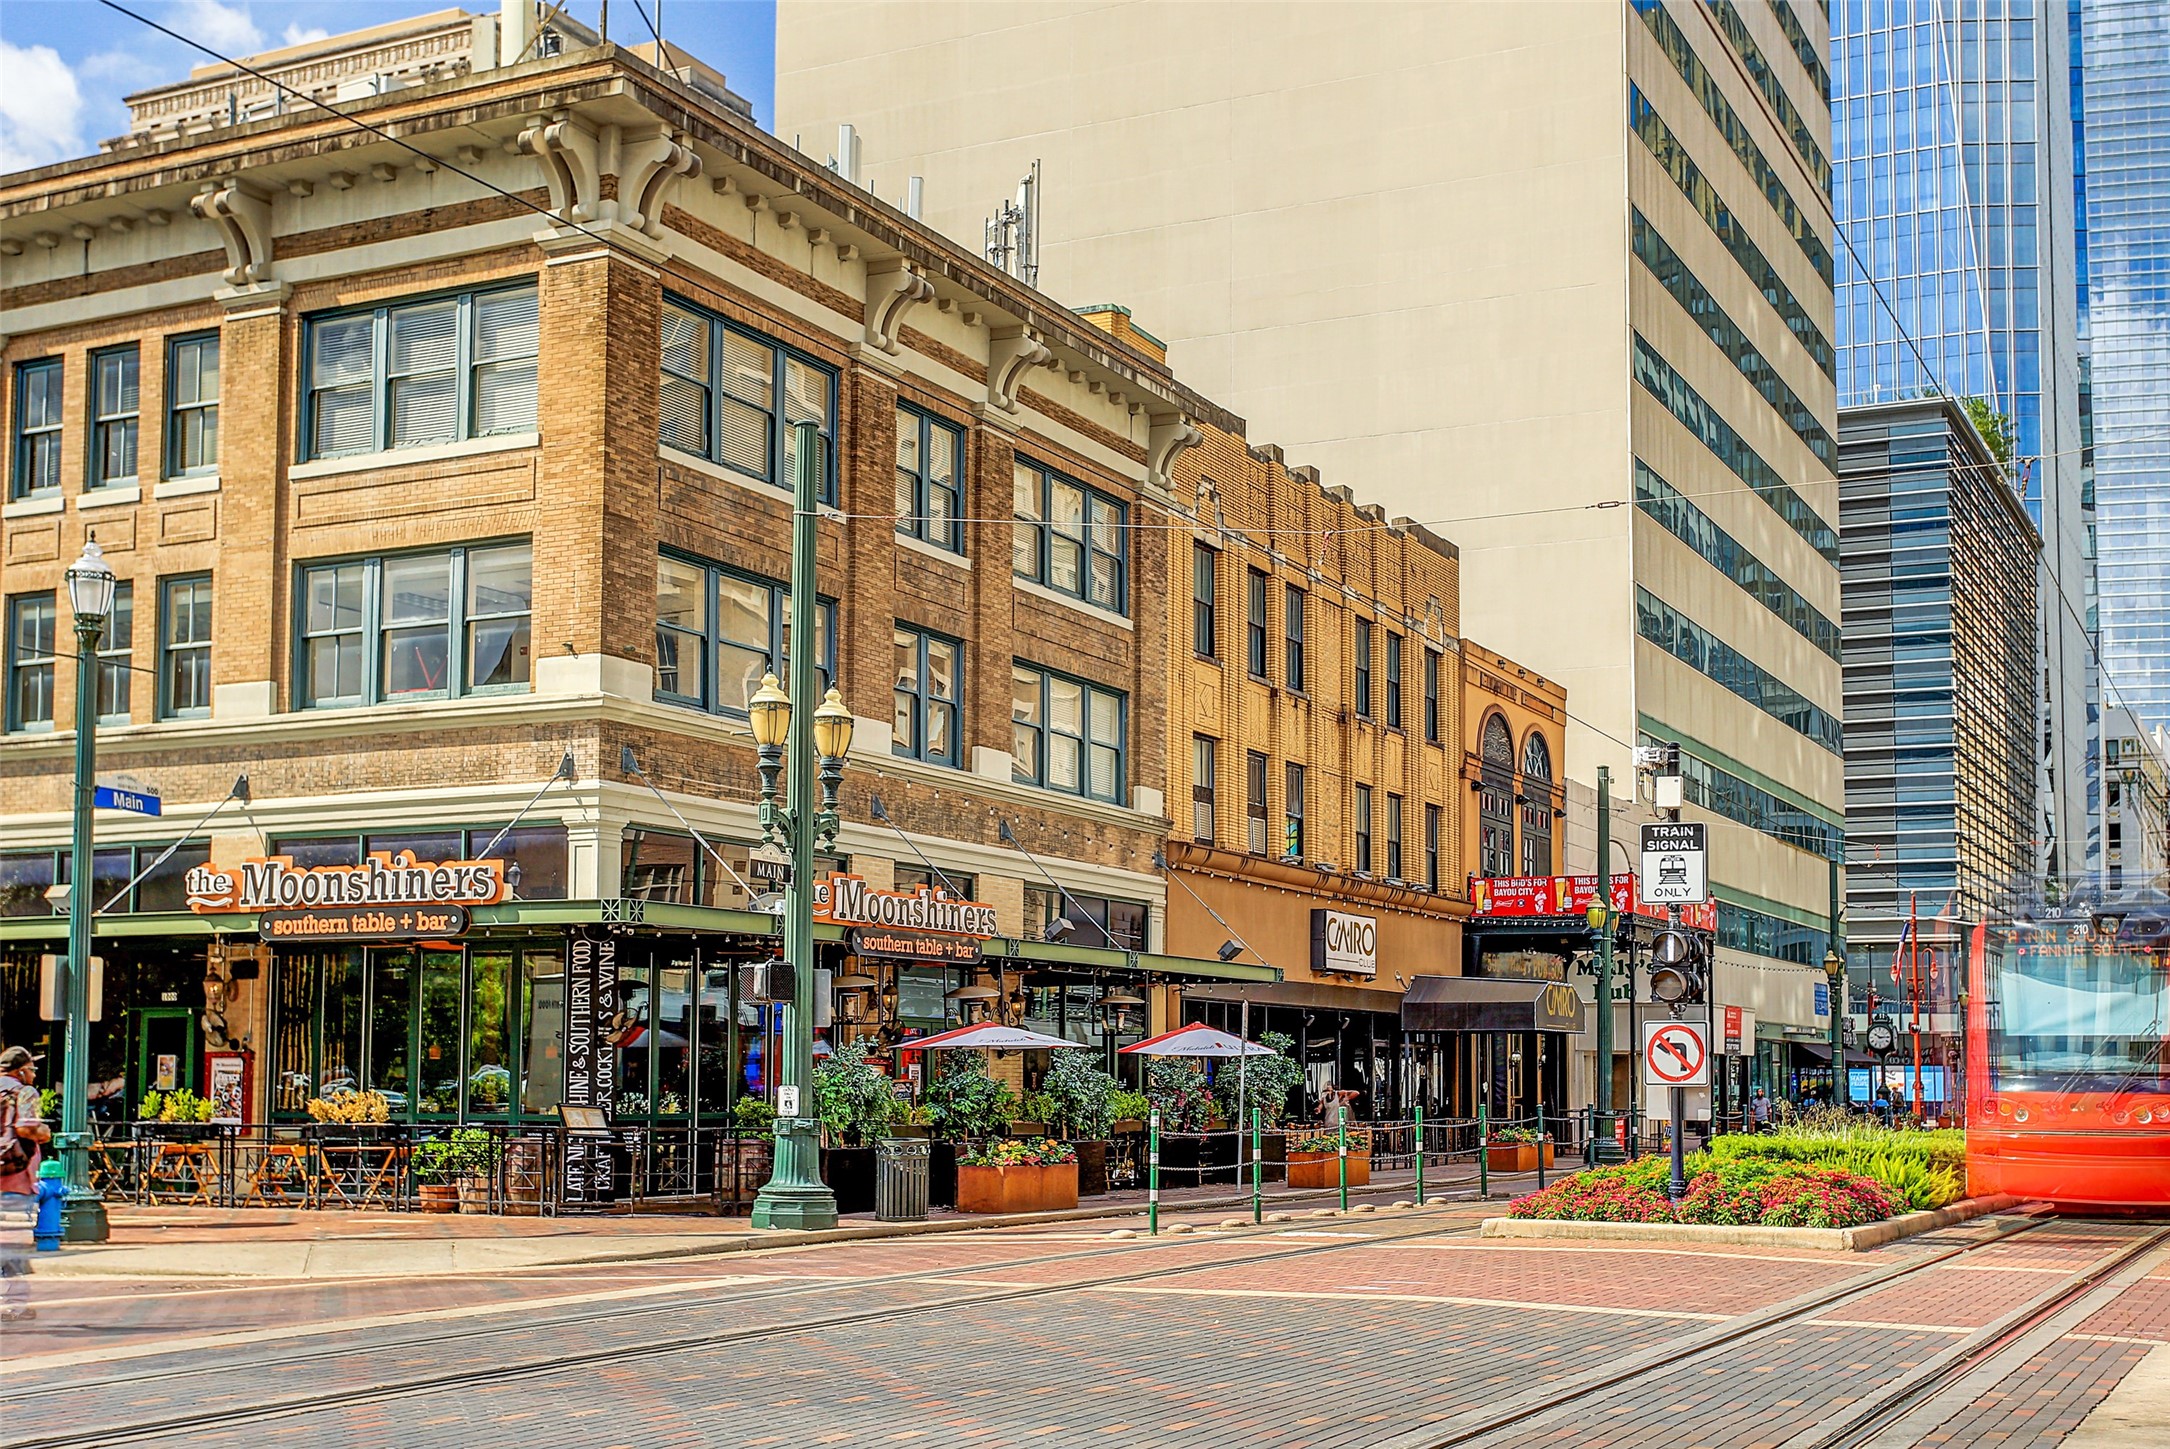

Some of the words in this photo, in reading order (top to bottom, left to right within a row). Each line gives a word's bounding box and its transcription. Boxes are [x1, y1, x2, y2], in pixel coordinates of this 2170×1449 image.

[113, 791, 144, 812] Main
[1652, 826, 1694, 838] TRAIN
[1646, 839, 1699, 851] SIGNAL
[186, 865, 233, 895] the
[239, 855, 498, 907] Moonshiners
[757, 862, 785, 880] MAIN
[1574, 877, 1590, 886] THIS
[1615, 875, 1629, 884] FOR
[1494, 879, 1510, 888] THIS
[1533, 878, 1548, 887] FOR
[1494, 888, 1517, 897] BAYOU
[1518, 887, 1535, 896] CITY.
[1654, 887, 1692, 898] ONLY
[833, 878, 998, 937] Moonshiners
[2045, 907, 2062, 919] 210
[272, 915, 349, 936] southern
[351, 912, 396, 934] table
[400, 914, 413, 930] +
[416, 910, 449, 931] bar
[2073, 924, 2089, 935] 210
[863, 934, 913, 952] southern
[915, 938, 943, 956] table
[945, 942, 953, 955] +
[955, 941, 974, 959] bar
[1327, 917, 1375, 957] CAIRO
[572, 939, 592, 974] FOOD
[2030, 944, 2084, 957] FANNIN
[599, 940, 616, 990] WINE
[1577, 957, 1653, 979] Mly's
[1546, 984, 1576, 1018] CAIRO
[569, 977, 592, 1055] SOUTHERN
